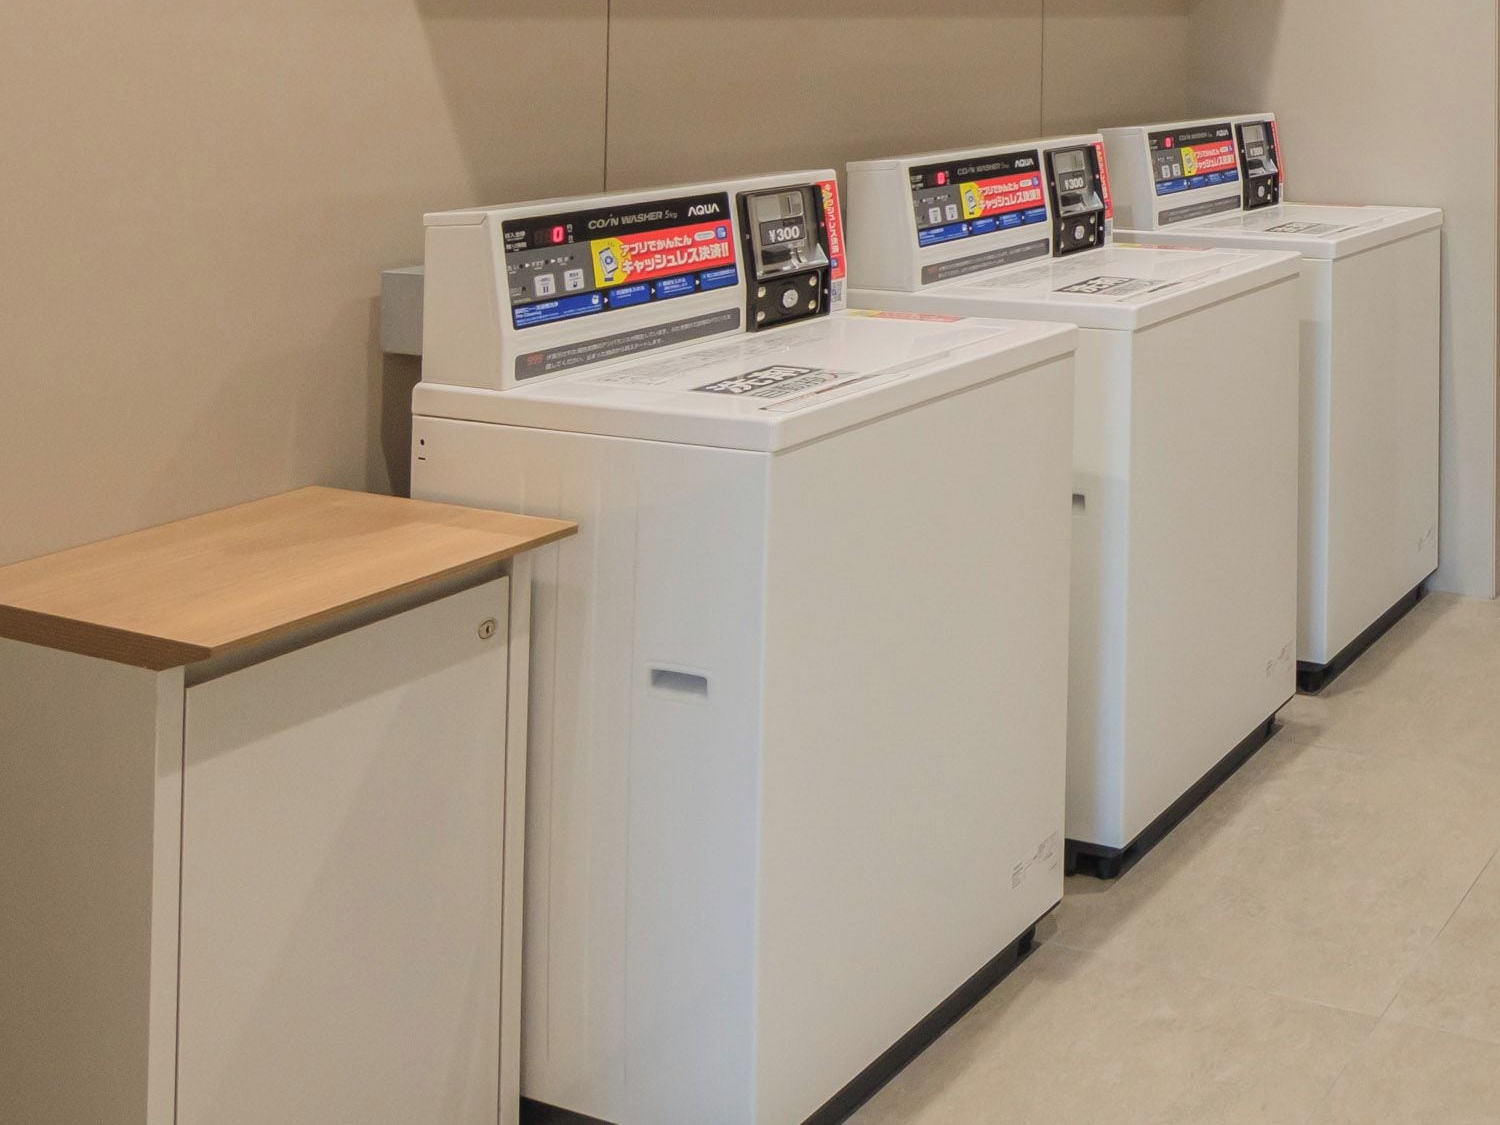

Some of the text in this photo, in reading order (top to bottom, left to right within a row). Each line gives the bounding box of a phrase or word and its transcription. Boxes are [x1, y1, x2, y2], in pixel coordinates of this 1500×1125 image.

[1015, 158, 1034, 169] AQUA
[687, 203, 720, 217] AQUA
[588, 213, 619, 230] COIN
[621, 211, 663, 225] WASHER
[552, 226, 564, 243] 0
[768, 225, 800, 243] ¥300
[620, 235, 693, 256] アプリでかんたん
